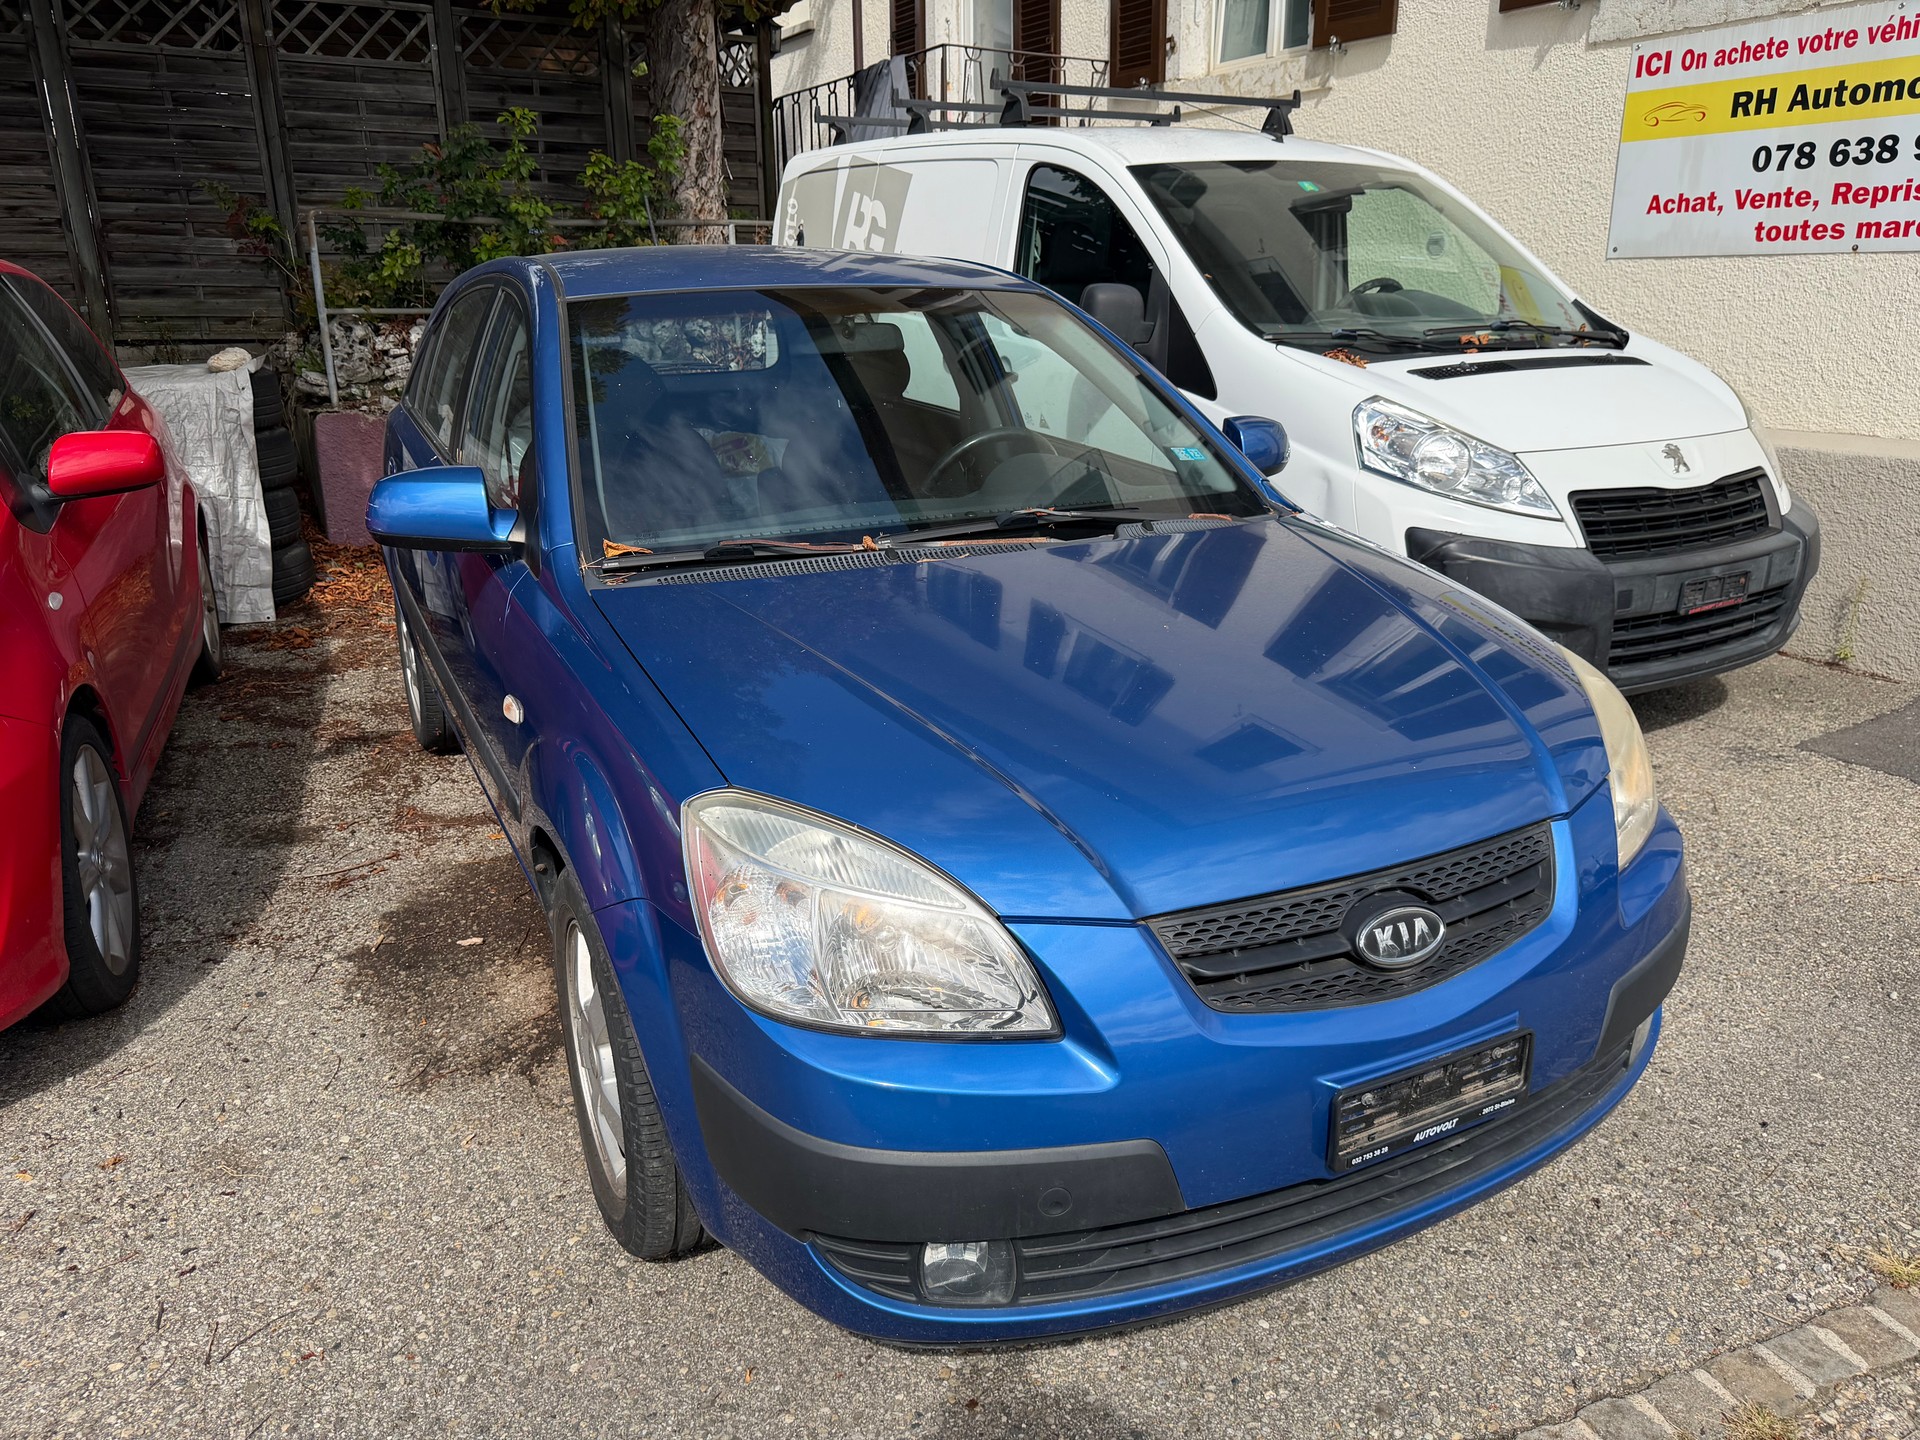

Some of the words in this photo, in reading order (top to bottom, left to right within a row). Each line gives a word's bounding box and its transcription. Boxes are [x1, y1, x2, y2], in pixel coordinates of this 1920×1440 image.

[1635, 50, 1673, 78] ICI
[1681, 49, 1707, 72] On
[1713, 38, 1789, 67] achete
[1797, 27, 1859, 54] votre
[1867, 13, 1920, 45] véhi
[1730, 87, 1778, 118] RH
[1752, 141, 1817, 172] 078
[1829, 134, 1900, 167] 638
[1646, 191, 1724, 215] Achat,
[1735, 186, 1820, 212] Vente,
[842, 191, 887, 252] RG
[1754, 219, 1846, 242] toutes
[1855, 220, 1920, 239] mar
[1373, 917, 1435, 956] KIA
[1413, 1117, 1460, 1143] AUTOVOLT
